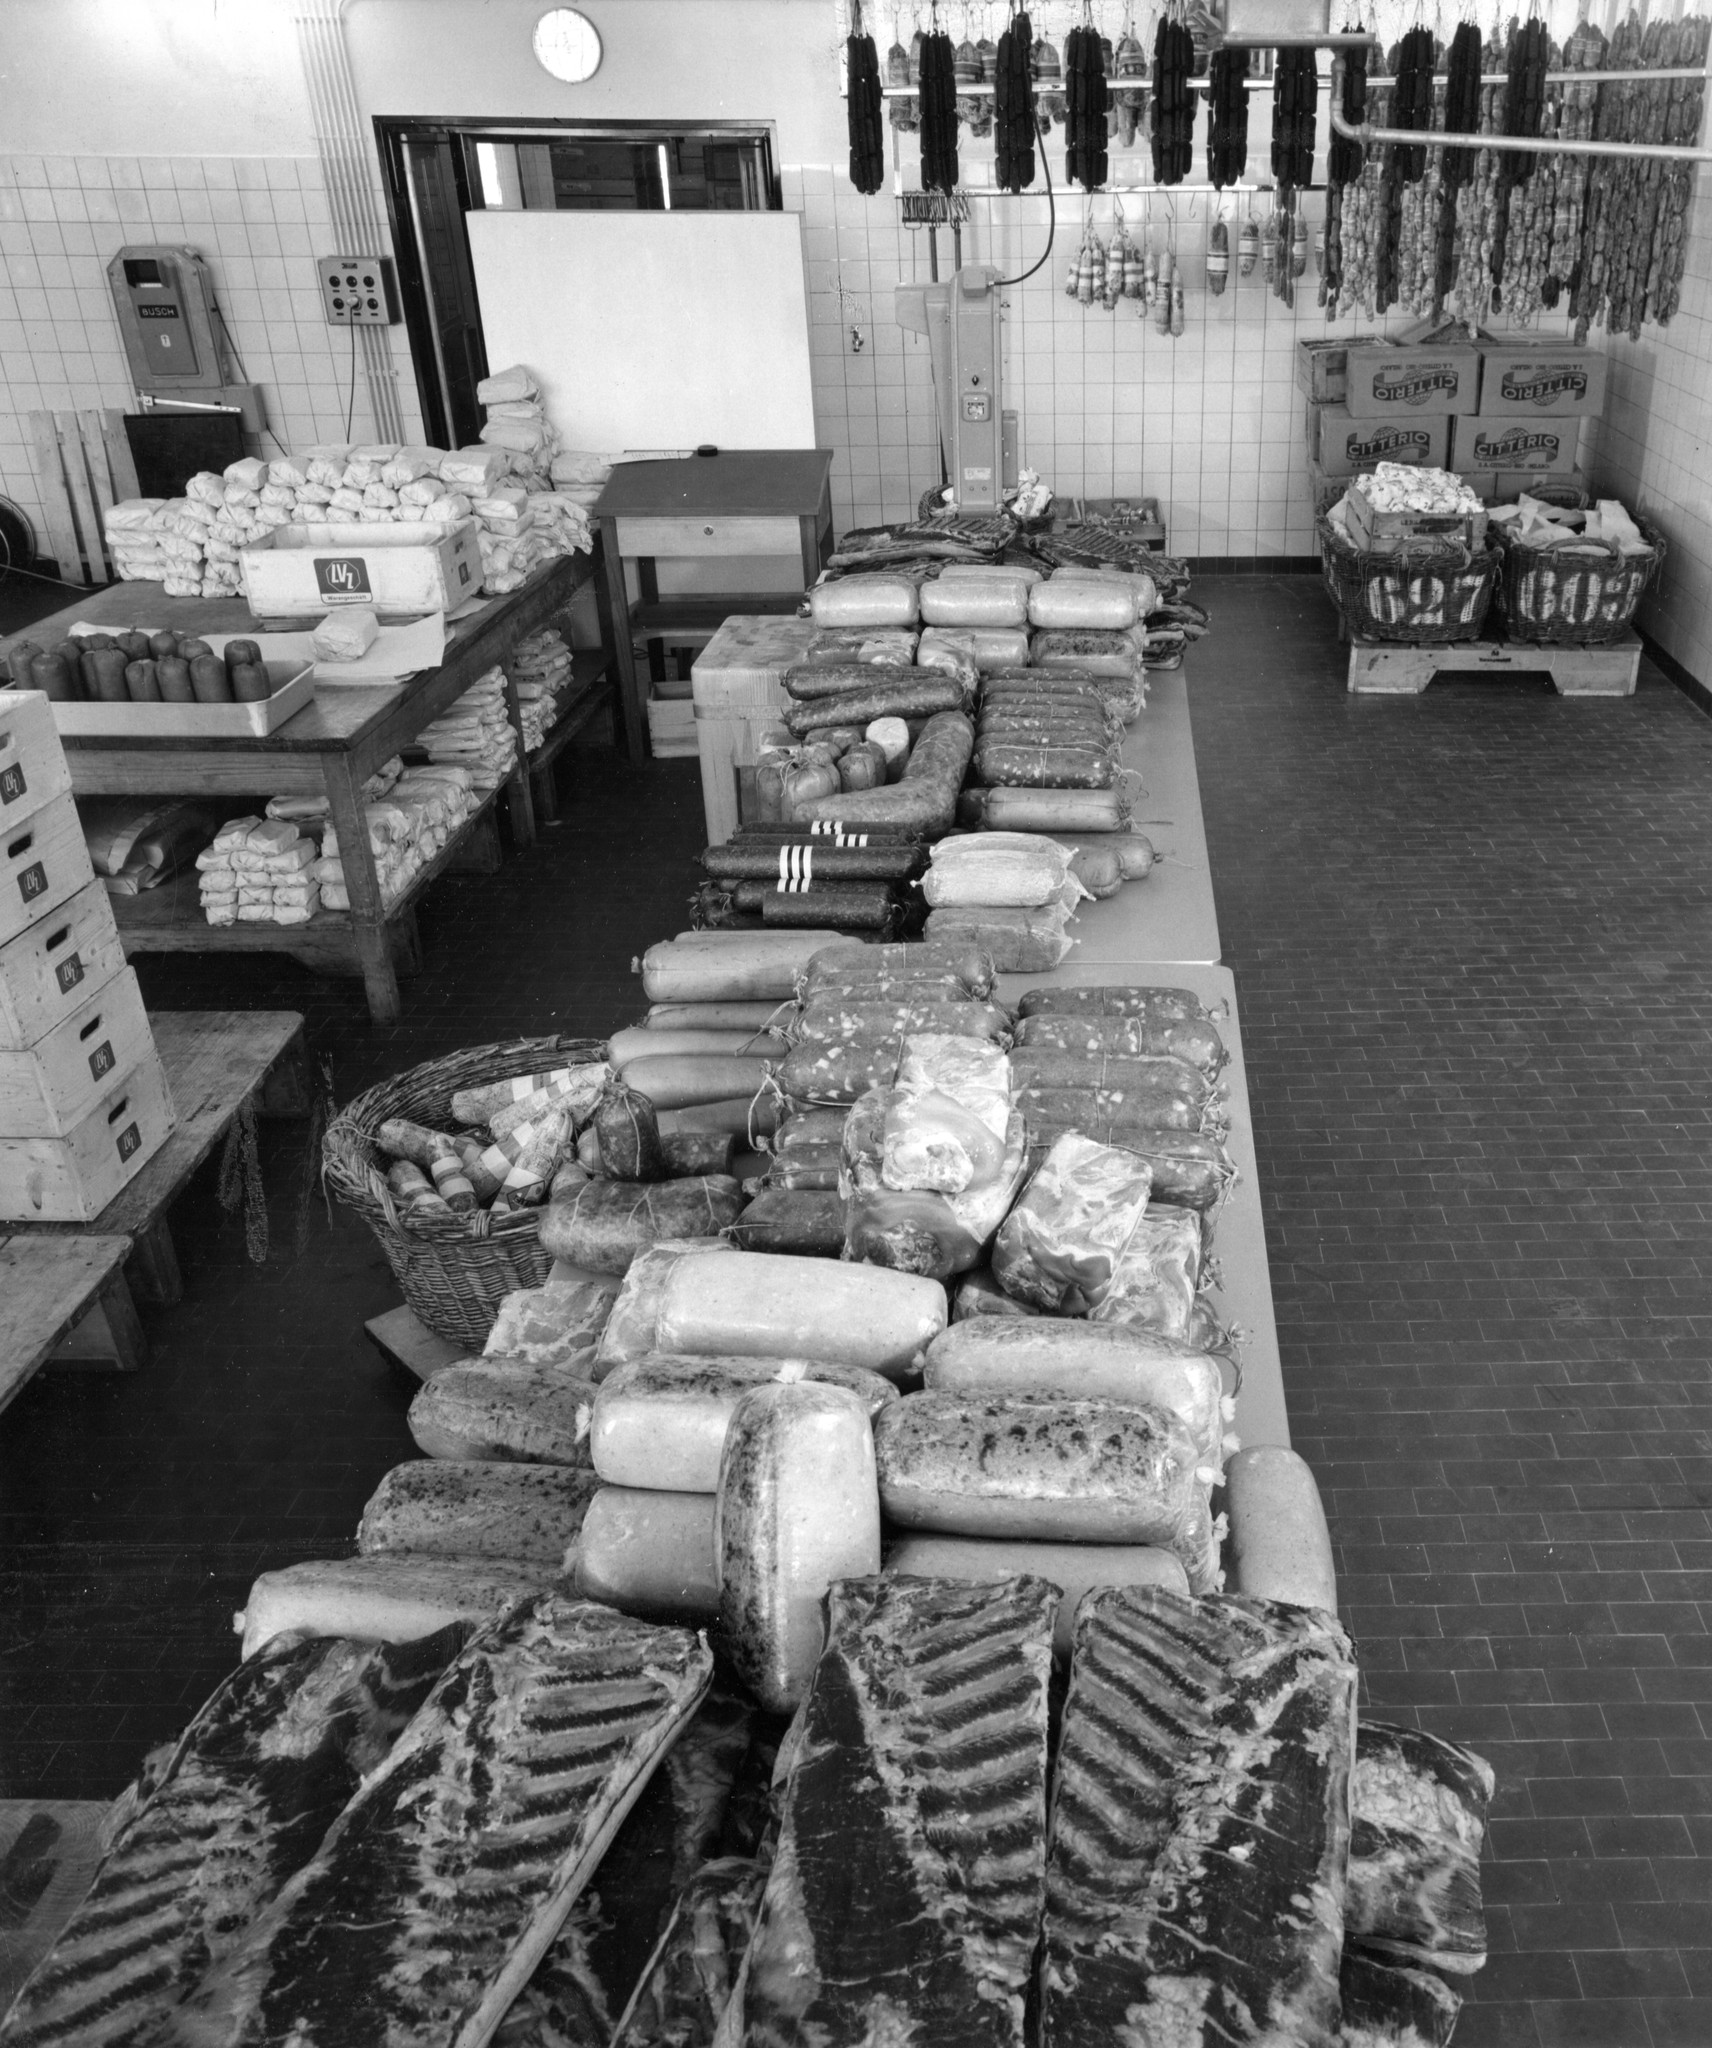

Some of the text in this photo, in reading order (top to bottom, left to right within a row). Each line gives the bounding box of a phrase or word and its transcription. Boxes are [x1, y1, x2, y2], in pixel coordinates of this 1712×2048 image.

[141, 306, 176, 317] BUSCH
[1375, 376, 1456, 399] CITTERIO
[1503, 377, 1585, 399] CITTERIO
[1348, 432, 1428, 455] CITTERIO
[1476, 435, 1557, 456] CITTERIO
[1369, 573, 1485, 625] 627
